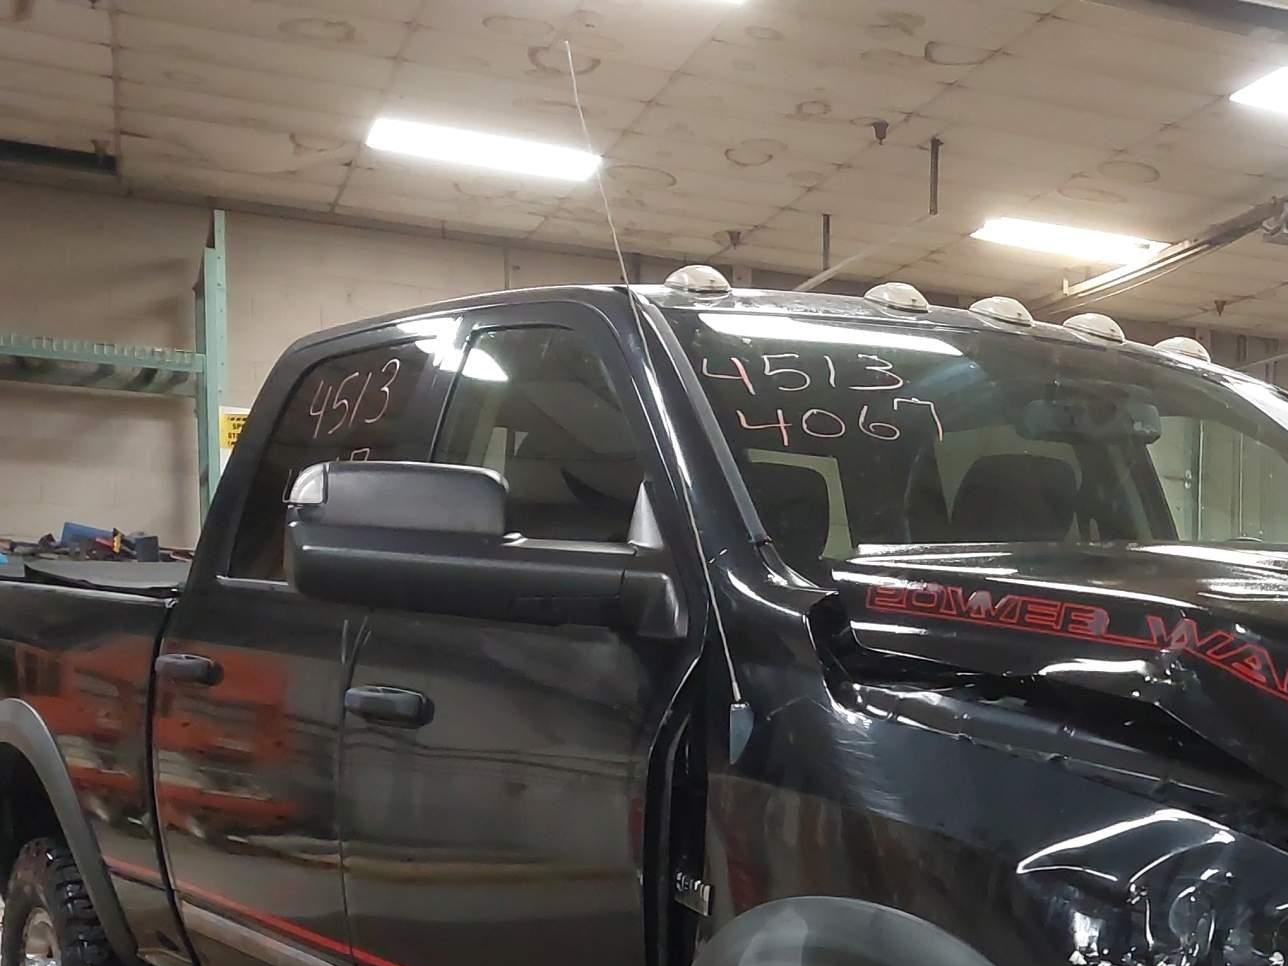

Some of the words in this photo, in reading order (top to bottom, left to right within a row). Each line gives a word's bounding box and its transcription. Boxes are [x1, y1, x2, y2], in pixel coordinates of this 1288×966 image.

[309, 358, 400, 439] 4513
[702, 353, 903, 396] 4513
[736, 397, 943, 447] 4067
[866, 584, 1110, 636] POWER
